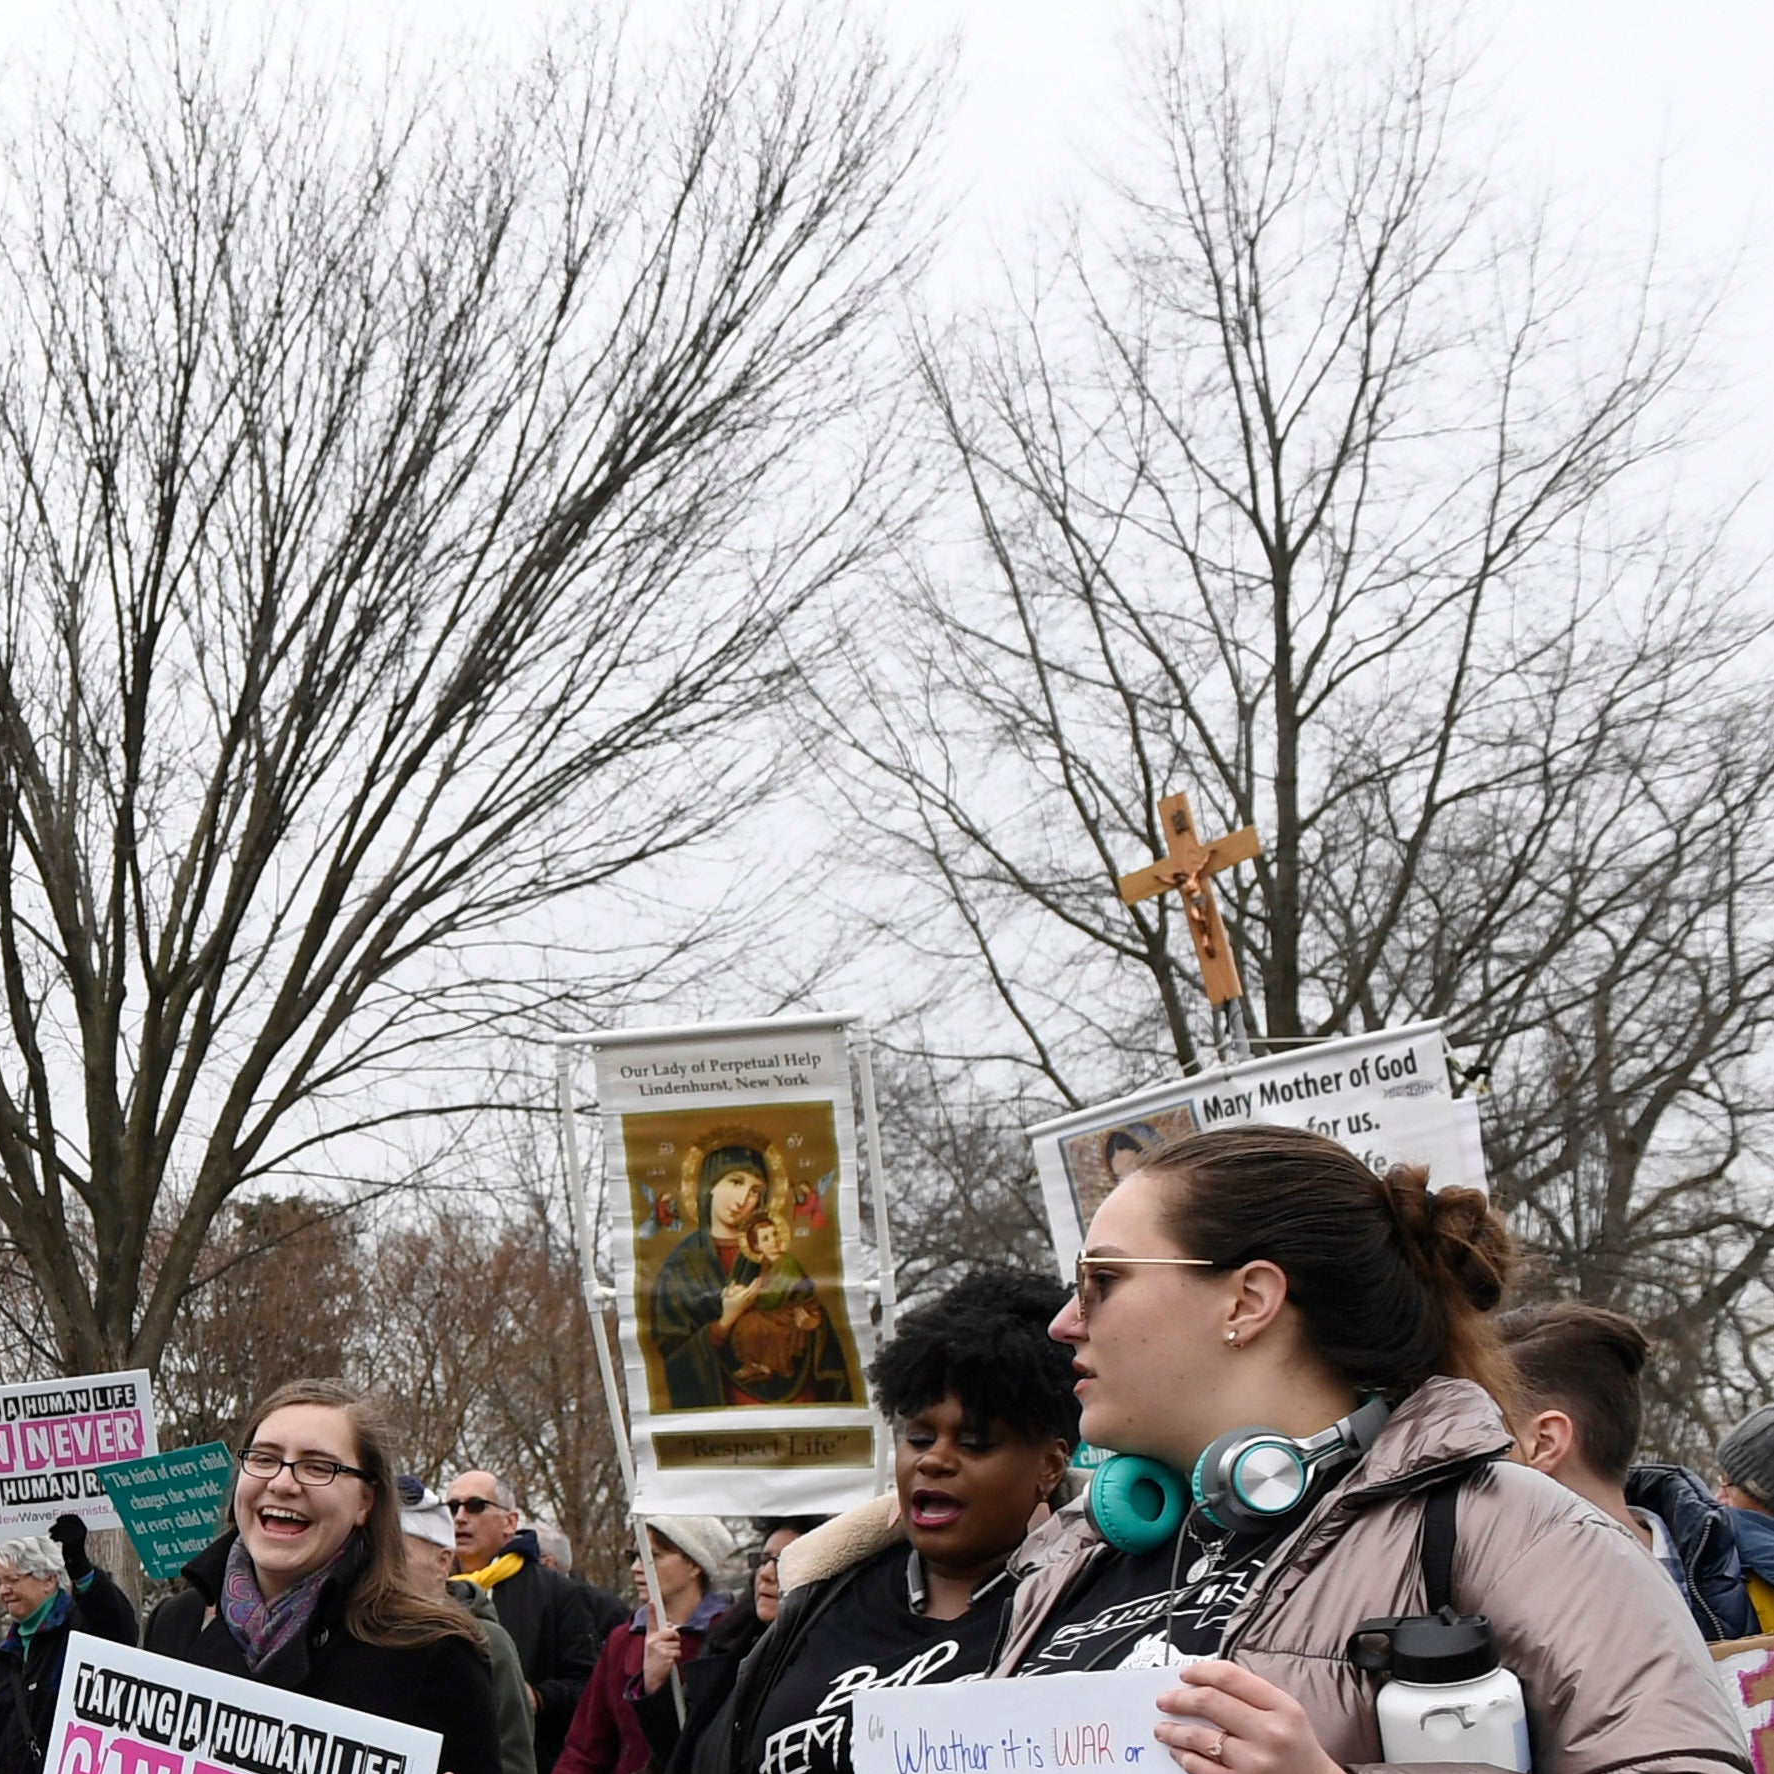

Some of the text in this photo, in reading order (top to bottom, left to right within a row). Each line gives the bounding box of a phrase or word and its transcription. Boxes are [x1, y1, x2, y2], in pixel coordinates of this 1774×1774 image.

[620, 1051, 822, 1080] Our Lady of Perpetual Help
[639, 1073, 809, 1097] Lindenhurst, New York
[1203, 1047, 1419, 1124] Mary Mother of God
[1306, 1111, 1381, 1138] for us.
[7, 1399, 19, 1418] A
[25, 1391, 89, 1416] HUMAN
[94, 1388, 135, 1407] LIFE
[26, 1416, 138, 1462] NEVER
[129, 1466, 159, 1485] birth
[157, 1463, 169, 1480] of
[169, 1461, 200, 1478] every
[199, 1451, 228, 1471] child
[3, 1474, 79, 1504] HUMAN
[130, 1480, 223, 1511] changes the world:
[131, 1519, 148, 1536] let
[148, 1517, 175, 1534] every
[174, 1508, 201, 1528] child
[200, 1507, 216, 1524] be
[153, 1540, 171, 1557] for
[171, 1543, 180, 1554] a
[176, 1537, 208, 1554] better
[76, 1668, 177, 1736] TAKING
[185, 1699, 203, 1745] A
[1001, 1729, 1022, 1769] it
[1026, 1737, 1044, 1768] is
[1052, 1722, 1115, 1766] WAR
[1124, 1745, 1145, 1764] or
